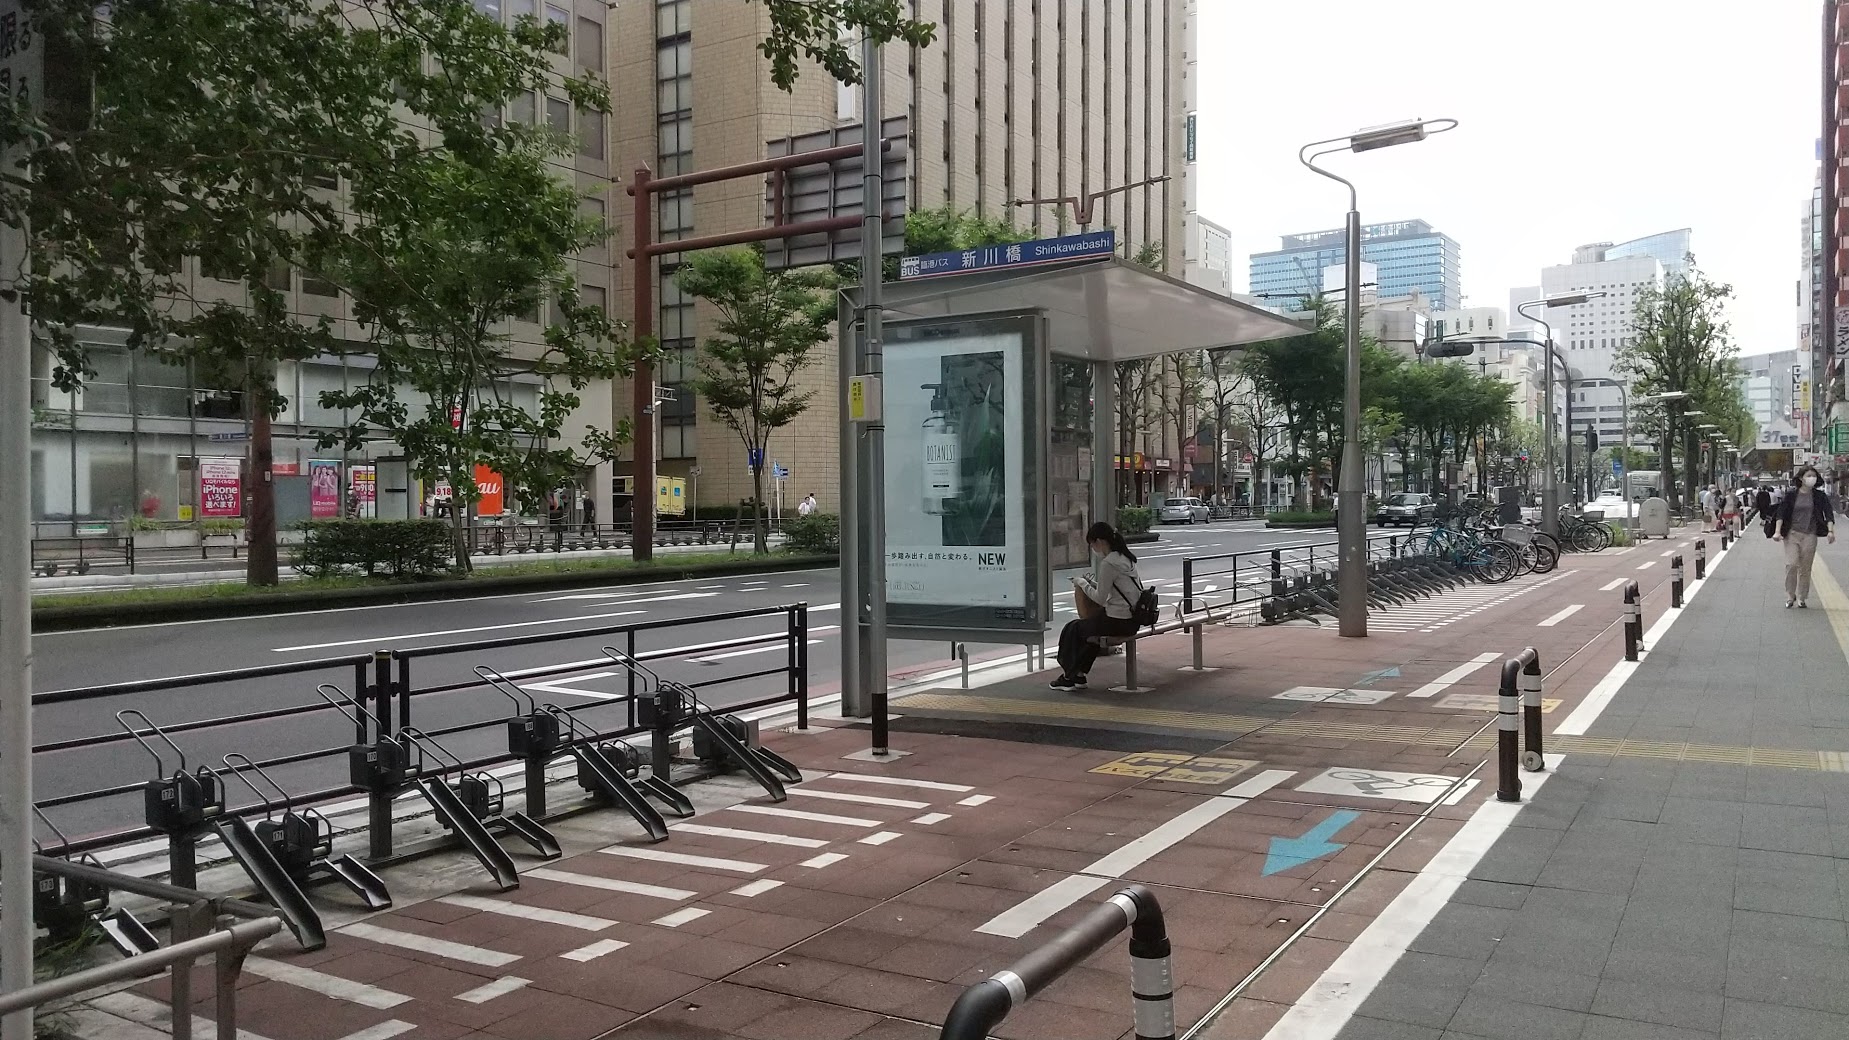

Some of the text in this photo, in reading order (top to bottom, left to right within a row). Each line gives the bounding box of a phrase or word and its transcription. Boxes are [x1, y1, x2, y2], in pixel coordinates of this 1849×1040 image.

[961, 244, 1021, 268] 新川橋
[1035, 237, 1110, 256] Shinkawabashi
[901, 266, 920, 277] BUS
[926, 444, 956, 462] BOTANIST
[203, 484, 238, 494] iPhone
[477, 482, 501, 495] au
[978, 552, 1007, 567] NEW
[367, 753, 377, 761] 170
[162, 789, 174, 799] 172
[273, 831, 284, 841] 171
